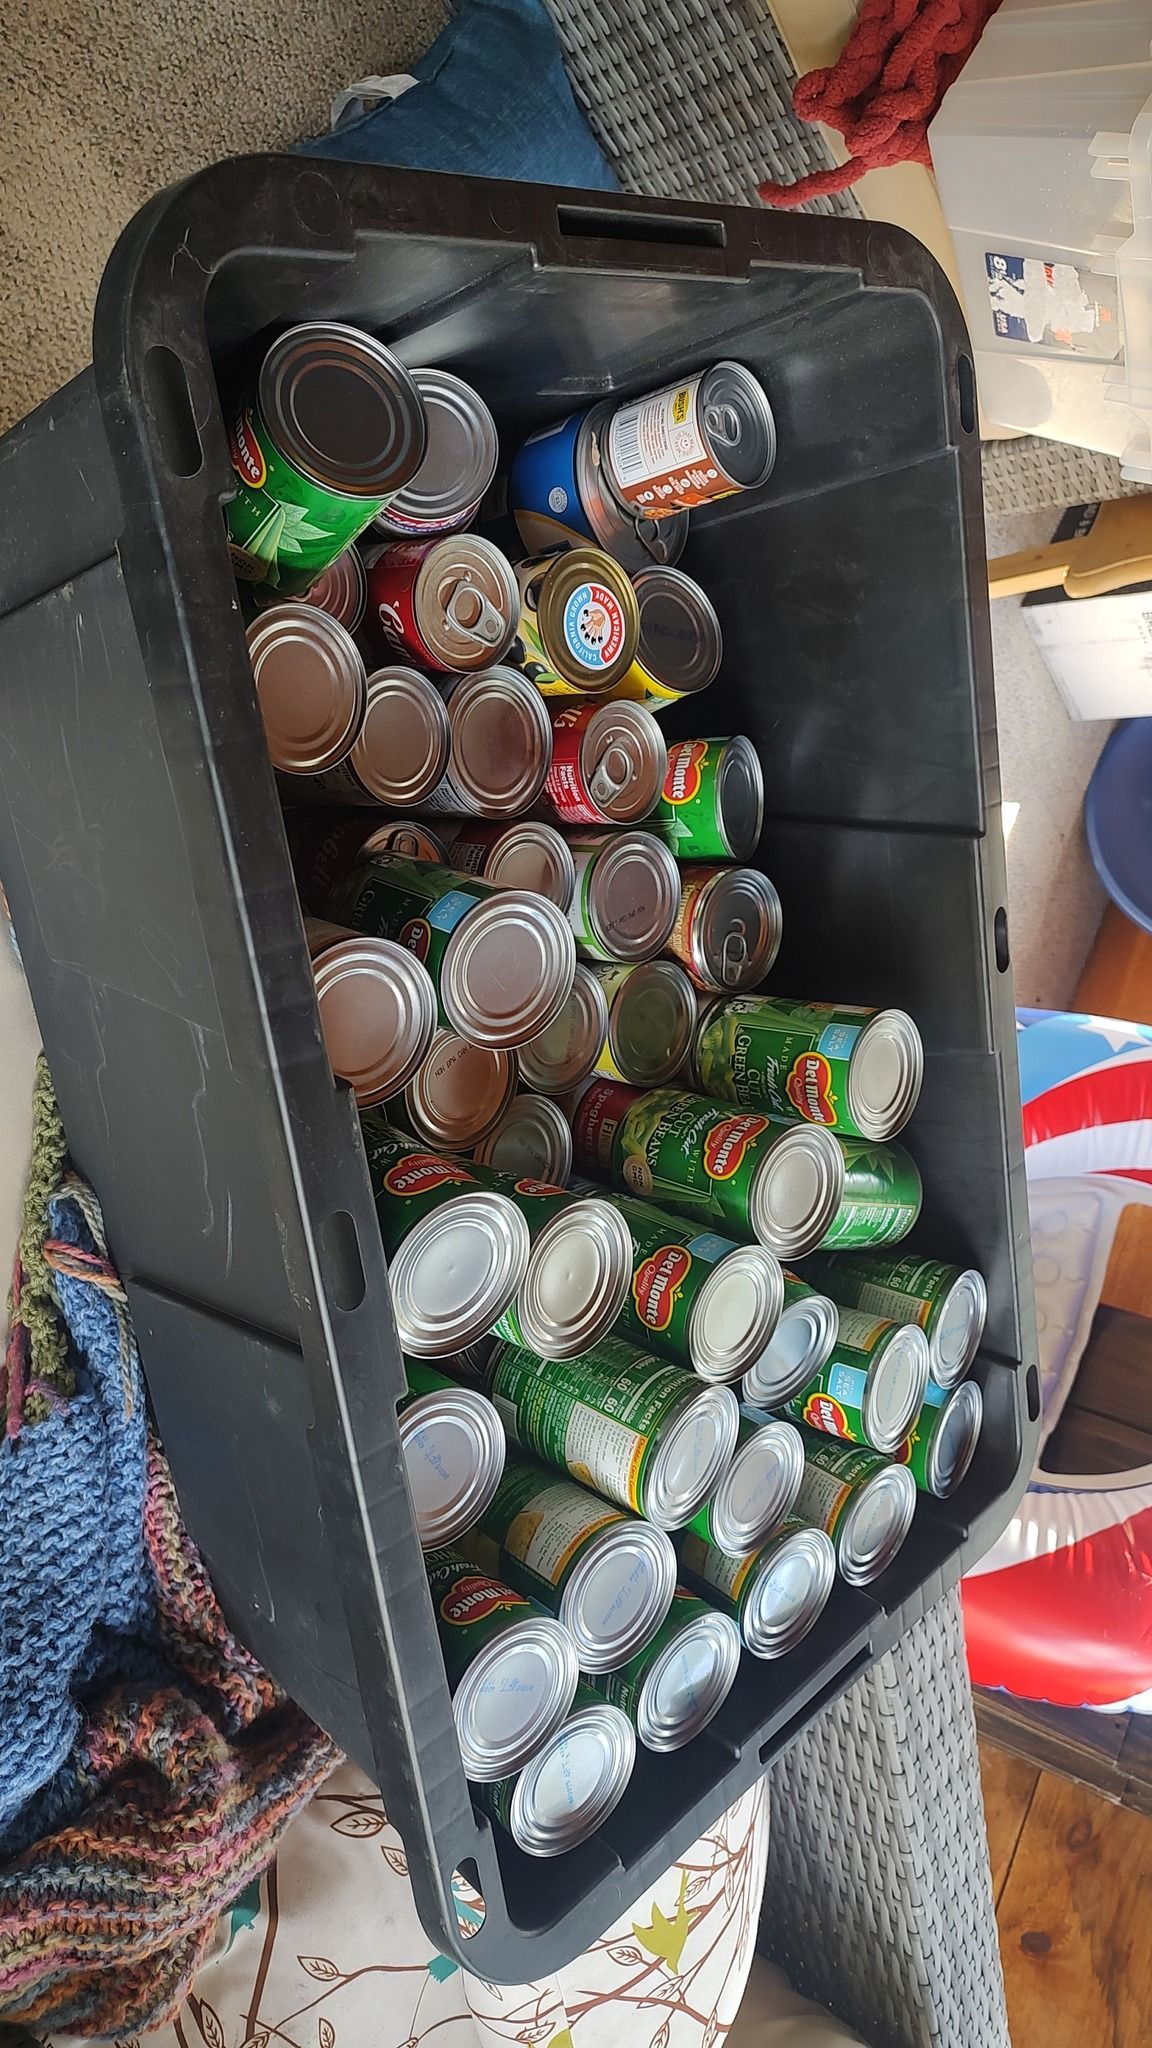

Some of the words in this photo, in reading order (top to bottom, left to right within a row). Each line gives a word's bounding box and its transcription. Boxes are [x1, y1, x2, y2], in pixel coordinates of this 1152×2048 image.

[676, 390, 687, 421] BUSH'S
[569, 591, 588, 618] GROWN
[596, 590, 615, 610] MADE
[568, 620, 598, 660] CALIFORNIA
[604, 611, 620, 658] AMERICAN
[560, 765, 570, 790] Facts
[567, 765, 581, 802] Nutrition
[734, 1034, 751, 1082] GREEN
[780, 1036, 794, 1071] MADE
[747, 1069, 761, 1096] CUT
[766, 1055, 780, 1089] Fresh
[805, 1059, 820, 1084] Del
[668, 1111, 695, 1138] CUT
[694, 1107, 720, 1131] Fresh
[646, 1119, 671, 1167] BEANS
[710, 1123, 733, 1149] Quality
[712, 1129, 746, 1174] Monte
[631, 1164, 640, 1186] GMO
[635, 1166, 645, 1187] NON
[686, 1149, 701, 1184] WITH
[640, 1228, 667, 1255] MADE
[659, 1251, 683, 1275] Del
[638, 1264, 656, 1296] Quality
[890, 1276, 902, 1288] 60
[646, 1273, 669, 1324] Monte
[617, 1377, 633, 1392] 60
[835, 1371, 846, 1395] SALT
[841, 1375, 851, 1398] SEA
[603, 1397, 618, 1413] 60
[638, 1399, 663, 1431] Facts
[815, 1454, 830, 1465] 60
[449, 1587, 502, 1618] Monte
